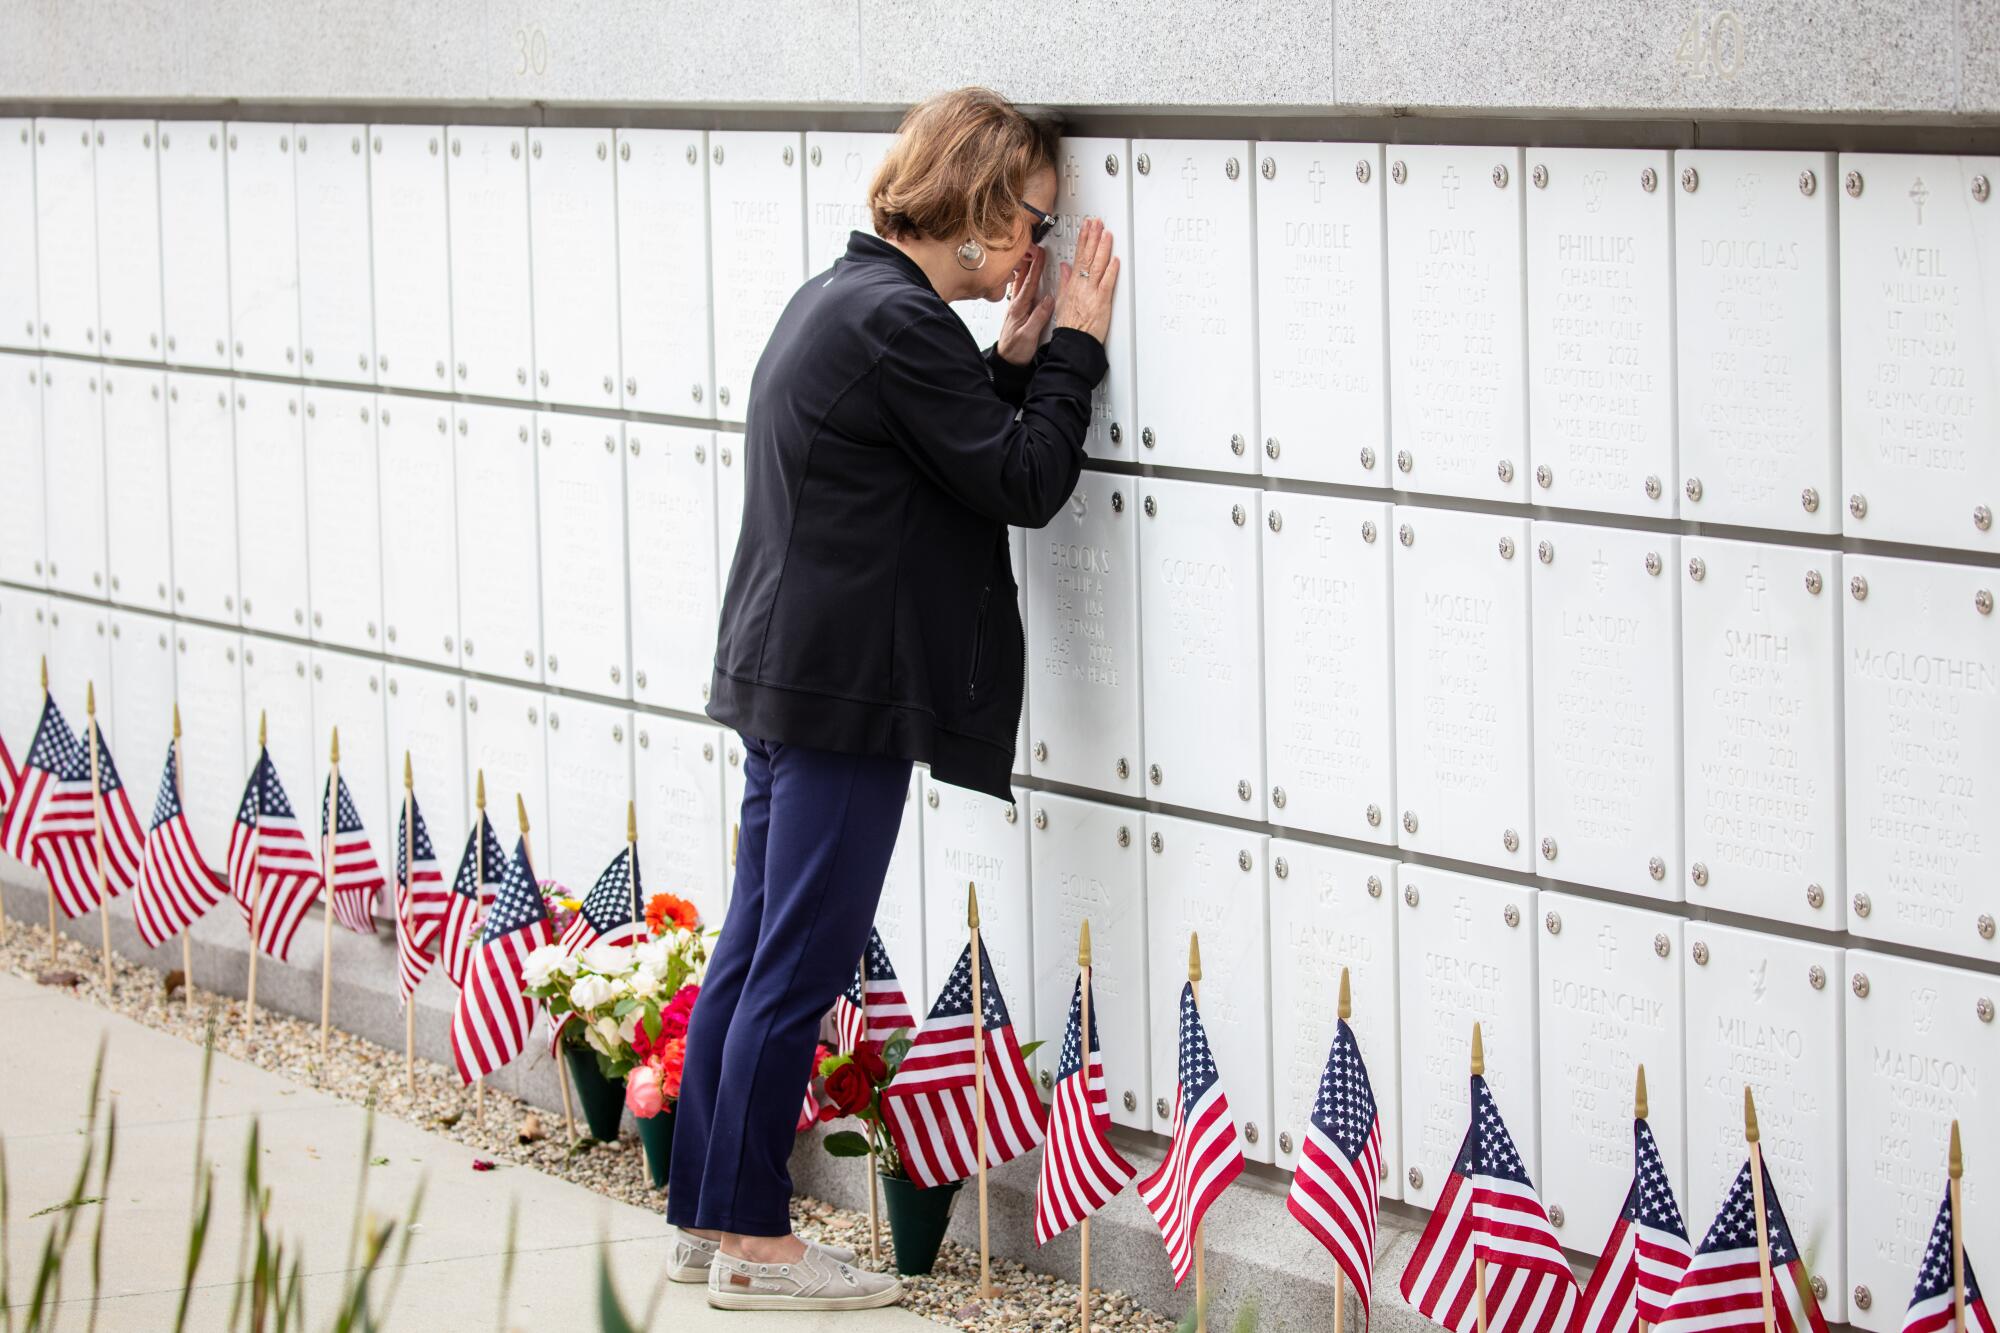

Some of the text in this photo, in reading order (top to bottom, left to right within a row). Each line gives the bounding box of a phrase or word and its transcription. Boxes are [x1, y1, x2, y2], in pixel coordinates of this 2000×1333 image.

[516, 29, 547, 76] 30
[1164, 217, 1217, 242] GREEN
[1285, 221, 1351, 248] DOUBLE
[1428, 229, 1476, 256] DAVIS
[1558, 234, 1634, 264] PHILLIPS
[1700, 239, 1799, 271] DOUGLAS
[1894, 246, 1946, 278] WEIL
[1561, 267, 1621, 289] CHARLES
[1882, 281, 1945, 305] WILLIAM
[1412, 309, 1495, 330] PERSIAN GULF
[1552, 318, 1643, 340] PERSIAN GULF
[1888, 310, 1953, 334] LT USN
[1464, 336, 1493, 354] 2022
[1728, 327, 1772, 348] KOREA
[1887, 337, 1956, 361] VIETNAM
[1409, 357, 1501, 380] MAY YOU HAVE
[1608, 347, 1639, 366] 2022
[1544, 367, 1653, 393] DEVOTED UNCLE
[1929, 366, 1966, 388] 2022
[1558, 394, 1639, 416] HONORABLE
[1867, 389, 1976, 417] PLAYING GOLF
[1421, 408, 1491, 429] WITH LOVE
[1553, 417, 1646, 443] WISE BELOVED
[1881, 417, 1962, 442] IN HEAVEN
[1420, 431, 1454, 448] FROM
[1569, 444, 1629, 465] BROTHER
[1880, 444, 1966, 471] WITH JESUS
[1568, 469, 1630, 491] GRANDPA
[1050, 542, 1110, 573] BROOKS
[1161, 558, 1233, 589] GORDON
[1424, 591, 1492, 624] MOSELY
[1433, 625, 1485, 649] THOMAS
[1562, 610, 1640, 646] LANDRY
[1724, 630, 1788, 664] SMITH
[1729, 664, 1764, 686] GARY
[1853, 647, 1997, 691] McGLOTHEN
[1557, 693, 1646, 722] PERSIAN GULF
[1713, 688, 1802, 717] CAPT USAF
[1888, 687, 1941, 712] LONNA
[1426, 720, 1495, 746] CHERISHED
[1613, 725, 1644, 748] 2022
[1726, 716, 1790, 742] VIETNAM
[1932, 720, 1959, 742] USA
[1553, 741, 1654, 773] WELL DONE MY
[1768, 748, 1798, 770] 2021
[1890, 740, 1959, 768] VIETNAM
[1435, 770, 1487, 792] MEMORY
[1566, 768, 1640, 797] GOOD AND
[1701, 763, 1800, 796] MY SOULMATE
[1938, 773, 1974, 798] 2022
[1573, 794, 1632, 820] FAITHFUL
[1706, 789, 1809, 822] LOVE FOREVER
[1882, 793, 1968, 823] RESTING IN
[1577, 819, 1631, 843] SERVANT
[1703, 814, 1814, 850] GONE BUT NOT
[1869, 817, 1981, 854] PERFECT PEACE
[944, 848, 1004, 881] MURPHY
[1715, 842, 1801, 873] FORGOTTEN
[1908, 850, 1959, 876] FAMILY
[1888, 874, 1963, 904] MAN AND
[1897, 901, 1955, 929] PATRIOT
[1290, 921, 1372, 962] LANKARD
[1425, 952, 1501, 992] SPENCER
[1590, 1023, 1627, 1042] ADAM
[1717, 1015, 1802, 1060] MILANO
[1728, 1052, 1776, 1075] JOSEPH
[1873, 1046, 1977, 1096] MADISON
[1565, 1064, 1610, 1090] WORLD
[1792, 1090, 1817, 1112] USA
[1891, 1085, 1959, 1117] NORMAN
[1571, 1114, 1584, 1133] IN
[1770, 1137, 1804, 1161] 2022
[1779, 1168, 1813, 1190] MAN
[1875, 1161, 1941, 1192] HE LIVED
[1899, 1192, 1919, 1213] TO
